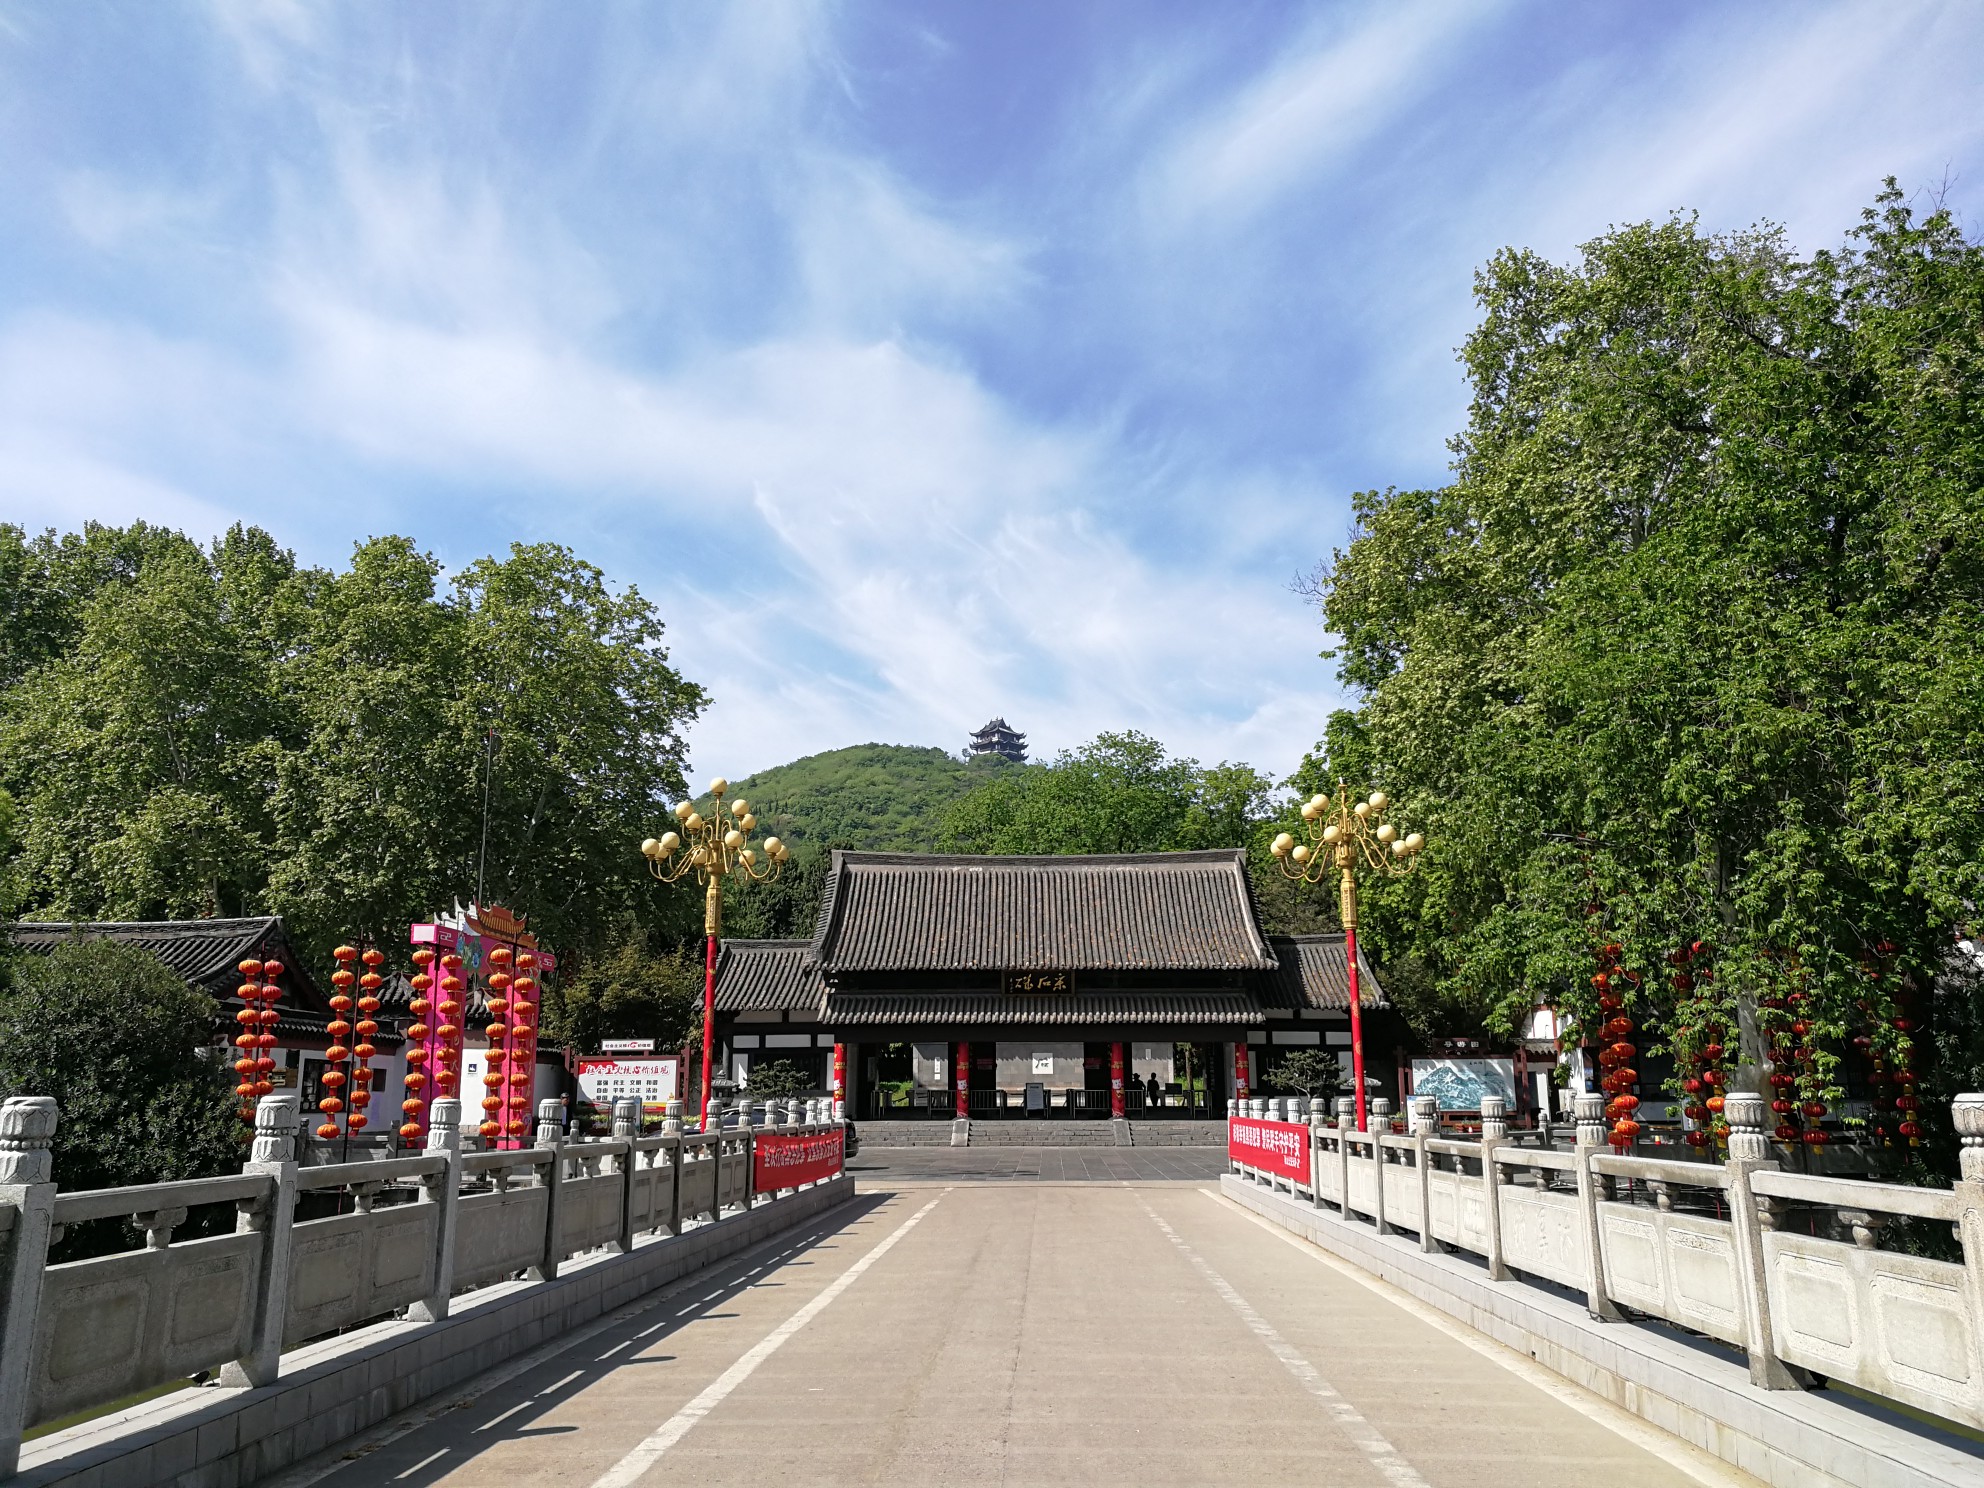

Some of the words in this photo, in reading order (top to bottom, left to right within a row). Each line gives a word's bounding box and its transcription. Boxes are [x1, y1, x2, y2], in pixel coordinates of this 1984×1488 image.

[586, 1064, 669, 1075] 社会主义核心价值观
